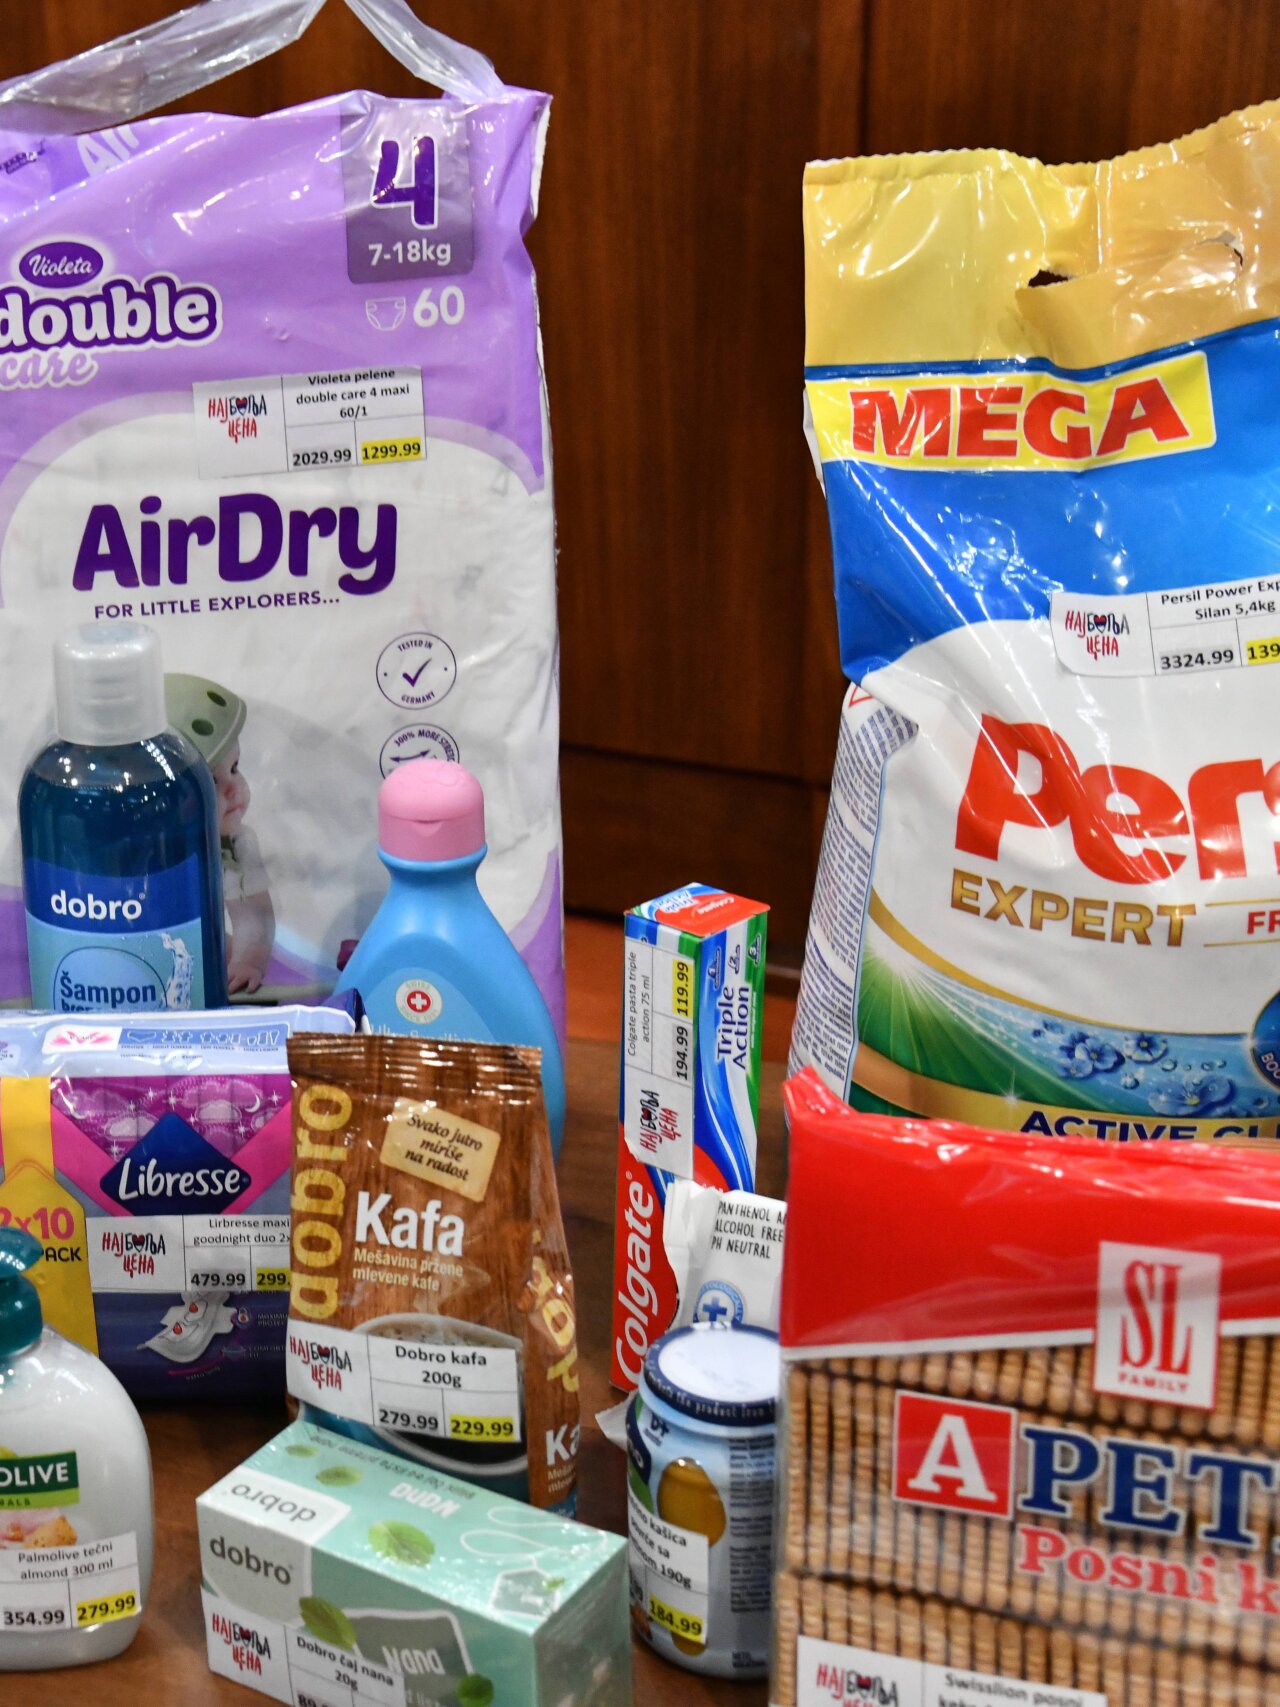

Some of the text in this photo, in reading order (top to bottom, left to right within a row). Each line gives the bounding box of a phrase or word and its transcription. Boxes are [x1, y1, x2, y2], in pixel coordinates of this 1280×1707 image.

[371, 134, 438, 229] 4
[29, 254, 93, 277] Violeta
[368, 238, 451, 267] 7-18kg
[413, 285, 465, 328] 60
[308, 369, 395, 386] Violeta pelene
[296, 384, 410, 405] double care 4 maxi
[340, 407, 367, 421] 60/1
[849, 376, 1191, 461] MEGA
[228, 418, 257, 443] ЦЕНА
[293, 442, 421, 466] 2029.99 1299.99
[72, 492, 398, 596] AirDry
[94, 589, 340, 619] FOR LITTLE EXPLORERS...
[1161, 586, 1253, 605] Persil Power
[1195, 601, 1276, 620] Silan 5,4kg
[398, 640, 433, 652] TESTED IN
[1087, 635, 1119, 661] ЦЕНА
[1161, 650, 1234, 670] 3324.99
[401, 691, 436, 704] GERMANY
[418, 730, 440, 741] MORE
[51, 889, 142, 920] dobro
[951, 868, 1196, 947] EXPERT
[60, 971, 156, 1009] Šampon
[627, 951, 637, 1057] Colgate pasta triple
[641, 975, 650, 1043] action 75 ml
[676, 961, 689, 1081] 119.99 194.99
[717, 986, 734, 1061] Triple
[732, 986, 749, 1070] Action
[407, 1113, 483, 1151] Svako jutro
[420, 1138, 464, 1162] miriše
[119, 1158, 240, 1200] Libresse
[405, 1149, 471, 1181] na radost
[291, 1084, 353, 1319] dobro
[718, 1201, 771, 1222] PANTHENOL
[209, 1218, 290, 1229] Lirbresse maxi
[355, 1191, 465, 1257] Kafa
[714, 1218, 783, 1242] ALCOHOL FREE
[193, 1233, 276, 1246] goodnight duo
[711, 1235, 771, 1260] PH NEUTRAL
[123, 1254, 154, 1278] ЦЕНА
[354, 1247, 463, 1277] Mešavina pržene
[191, 1273, 246, 1287] 479.99
[353, 1269, 440, 1292] mlevene kafe
[616, 1181, 657, 1386] Colgate
[1119, 1258, 1194, 1375] SL
[395, 1344, 487, 1367] Dobro kafa
[310, 1364, 342, 1391] ЦЕНА
[422, 1371, 462, 1388] 200g
[1118, 1372, 1189, 1394] FAMILY
[379, 1408, 514, 1437] 279.99 229.99
[231, 1480, 317, 1524] dobro
[649, 1520, 687, 1547] kašica
[18, 1542, 113, 1564] Palmolive tečni
[209, 1536, 293, 1587] dobro
[1019, 1526, 1218, 1604] Posni
[20, 1559, 113, 1580] almond 300 ml
[661, 1564, 692, 1589] 190g
[4, 1595, 136, 1626] 354.99 279.99
[649, 1600, 702, 1636] 184.99
[232, 1644, 262, 1676] ЦЕНА
[297, 1636, 394, 1687] Dobro čaj nana
[335, 1670, 358, 1691] 20g
[945, 1672, 1028, 1701] Swisslion
